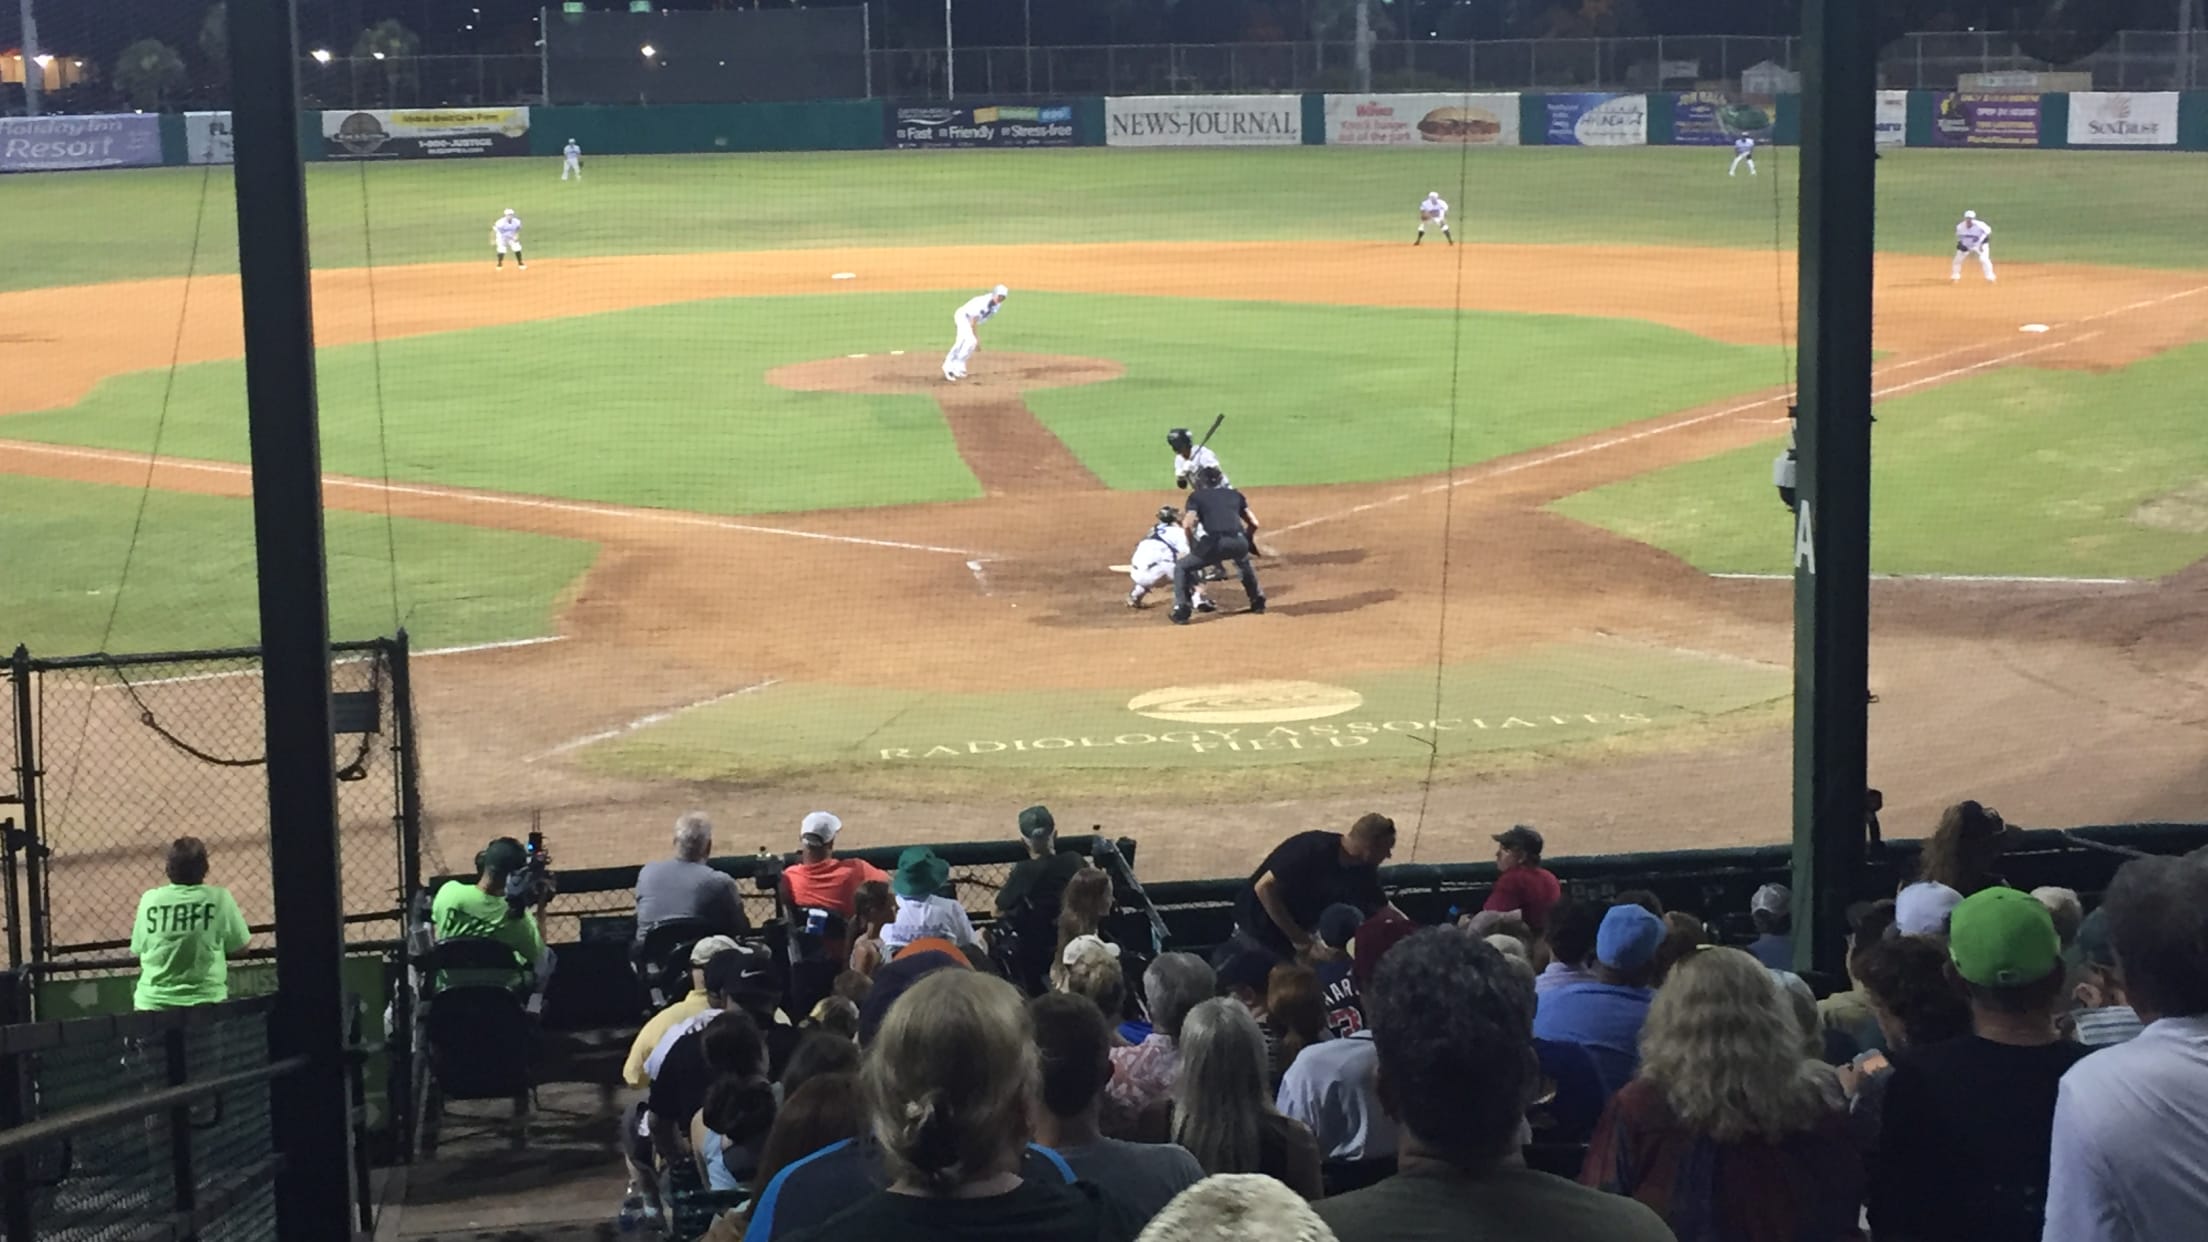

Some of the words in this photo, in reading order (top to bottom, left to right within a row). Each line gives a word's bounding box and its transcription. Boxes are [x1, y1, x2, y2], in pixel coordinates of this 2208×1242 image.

[0, 119, 84, 136] Holiday
[87, 119, 123, 132] Inn
[907, 127, 933, 140] Fast
[949, 125, 995, 140] Friendly
[1112, 111, 1297, 136] NEWS-JOURNAL
[6, 136, 114, 158] Resort
[1794, 499, 1816, 574] A
[879, 729, 1241, 760] RADIOLOGY
[1266, 712, 1652, 737] ASSOCIATES
[1191, 735, 1369, 753] FIELD
[145, 902, 216, 934] STAFF
